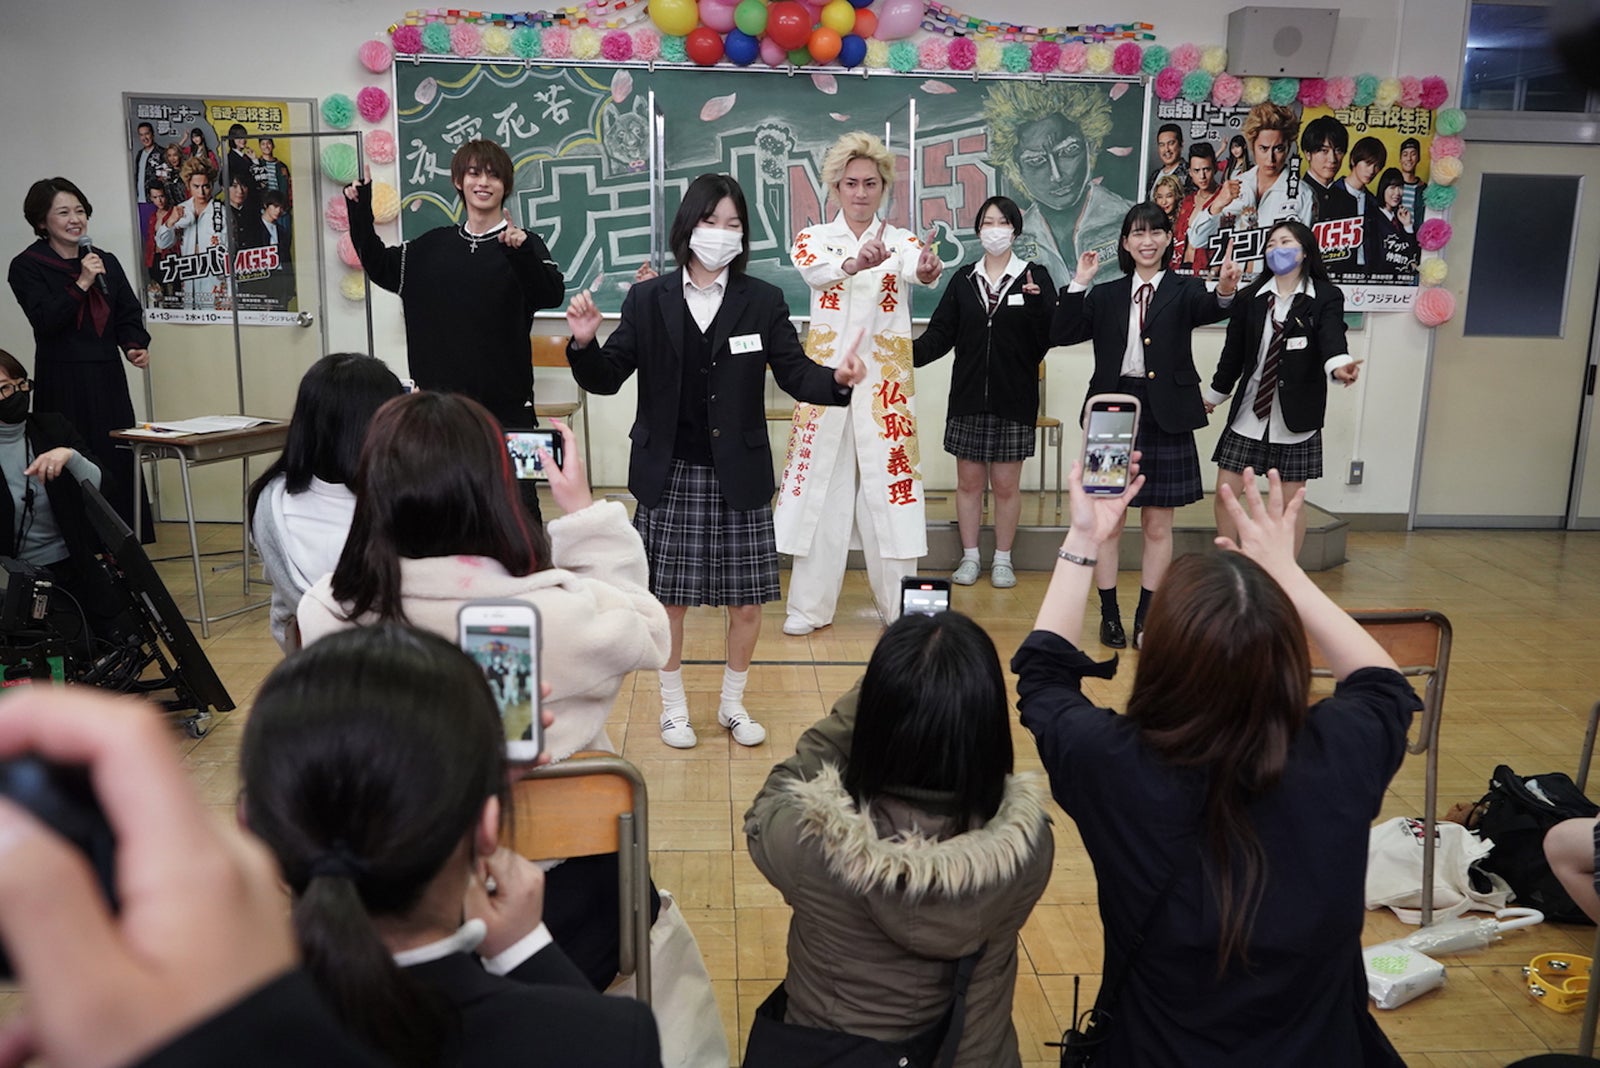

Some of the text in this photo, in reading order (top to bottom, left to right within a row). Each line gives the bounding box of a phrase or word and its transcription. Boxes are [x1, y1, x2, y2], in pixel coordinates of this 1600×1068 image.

[879, 273, 898, 313] 気合
[1367, 294, 1412, 304] フジテレビ
[878, 379, 917, 505] 仏恥義理
